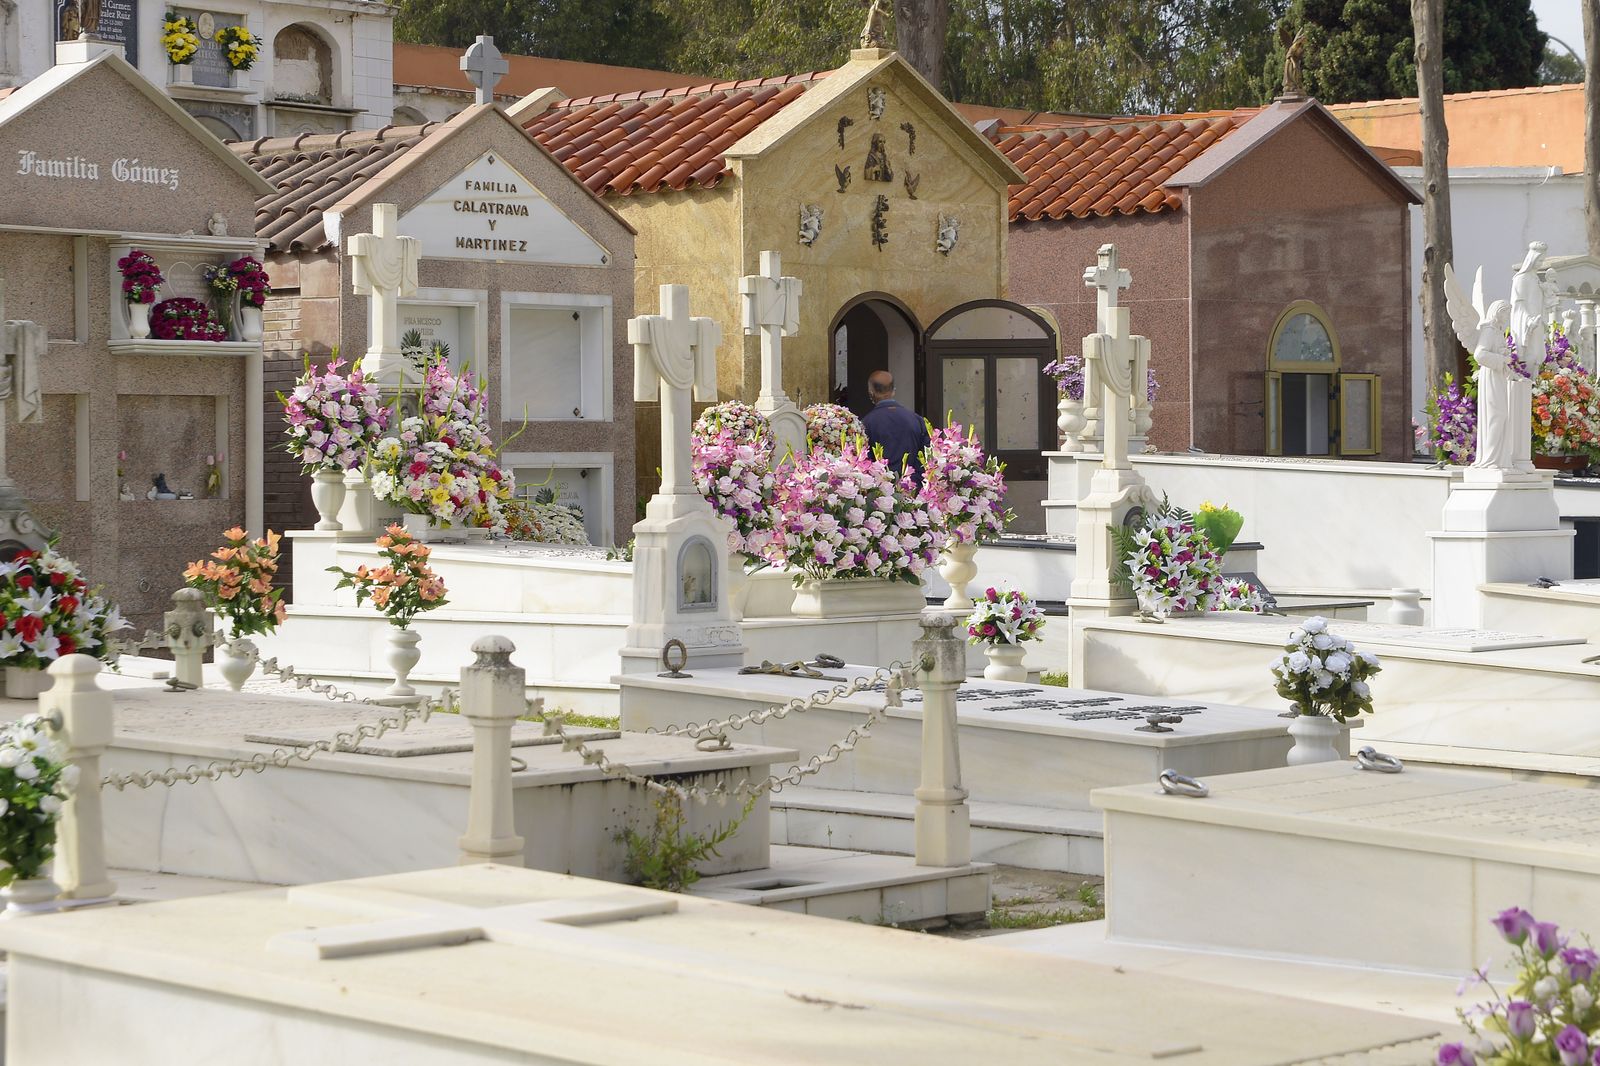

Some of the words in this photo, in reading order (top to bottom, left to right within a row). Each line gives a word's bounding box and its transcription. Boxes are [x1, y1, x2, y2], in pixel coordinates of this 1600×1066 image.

[107, 0, 131, 10] Carmen
[16, 150, 99, 180] Familia
[112, 158, 180, 191] Gómez
[465, 180, 517, 193] FAMILIA
[453, 200, 529, 216] CALATRAVA
[487, 219, 497, 231] Y
[455, 236, 528, 252] MARTINEZ
[403, 317, 442, 326] FRANCISCO
